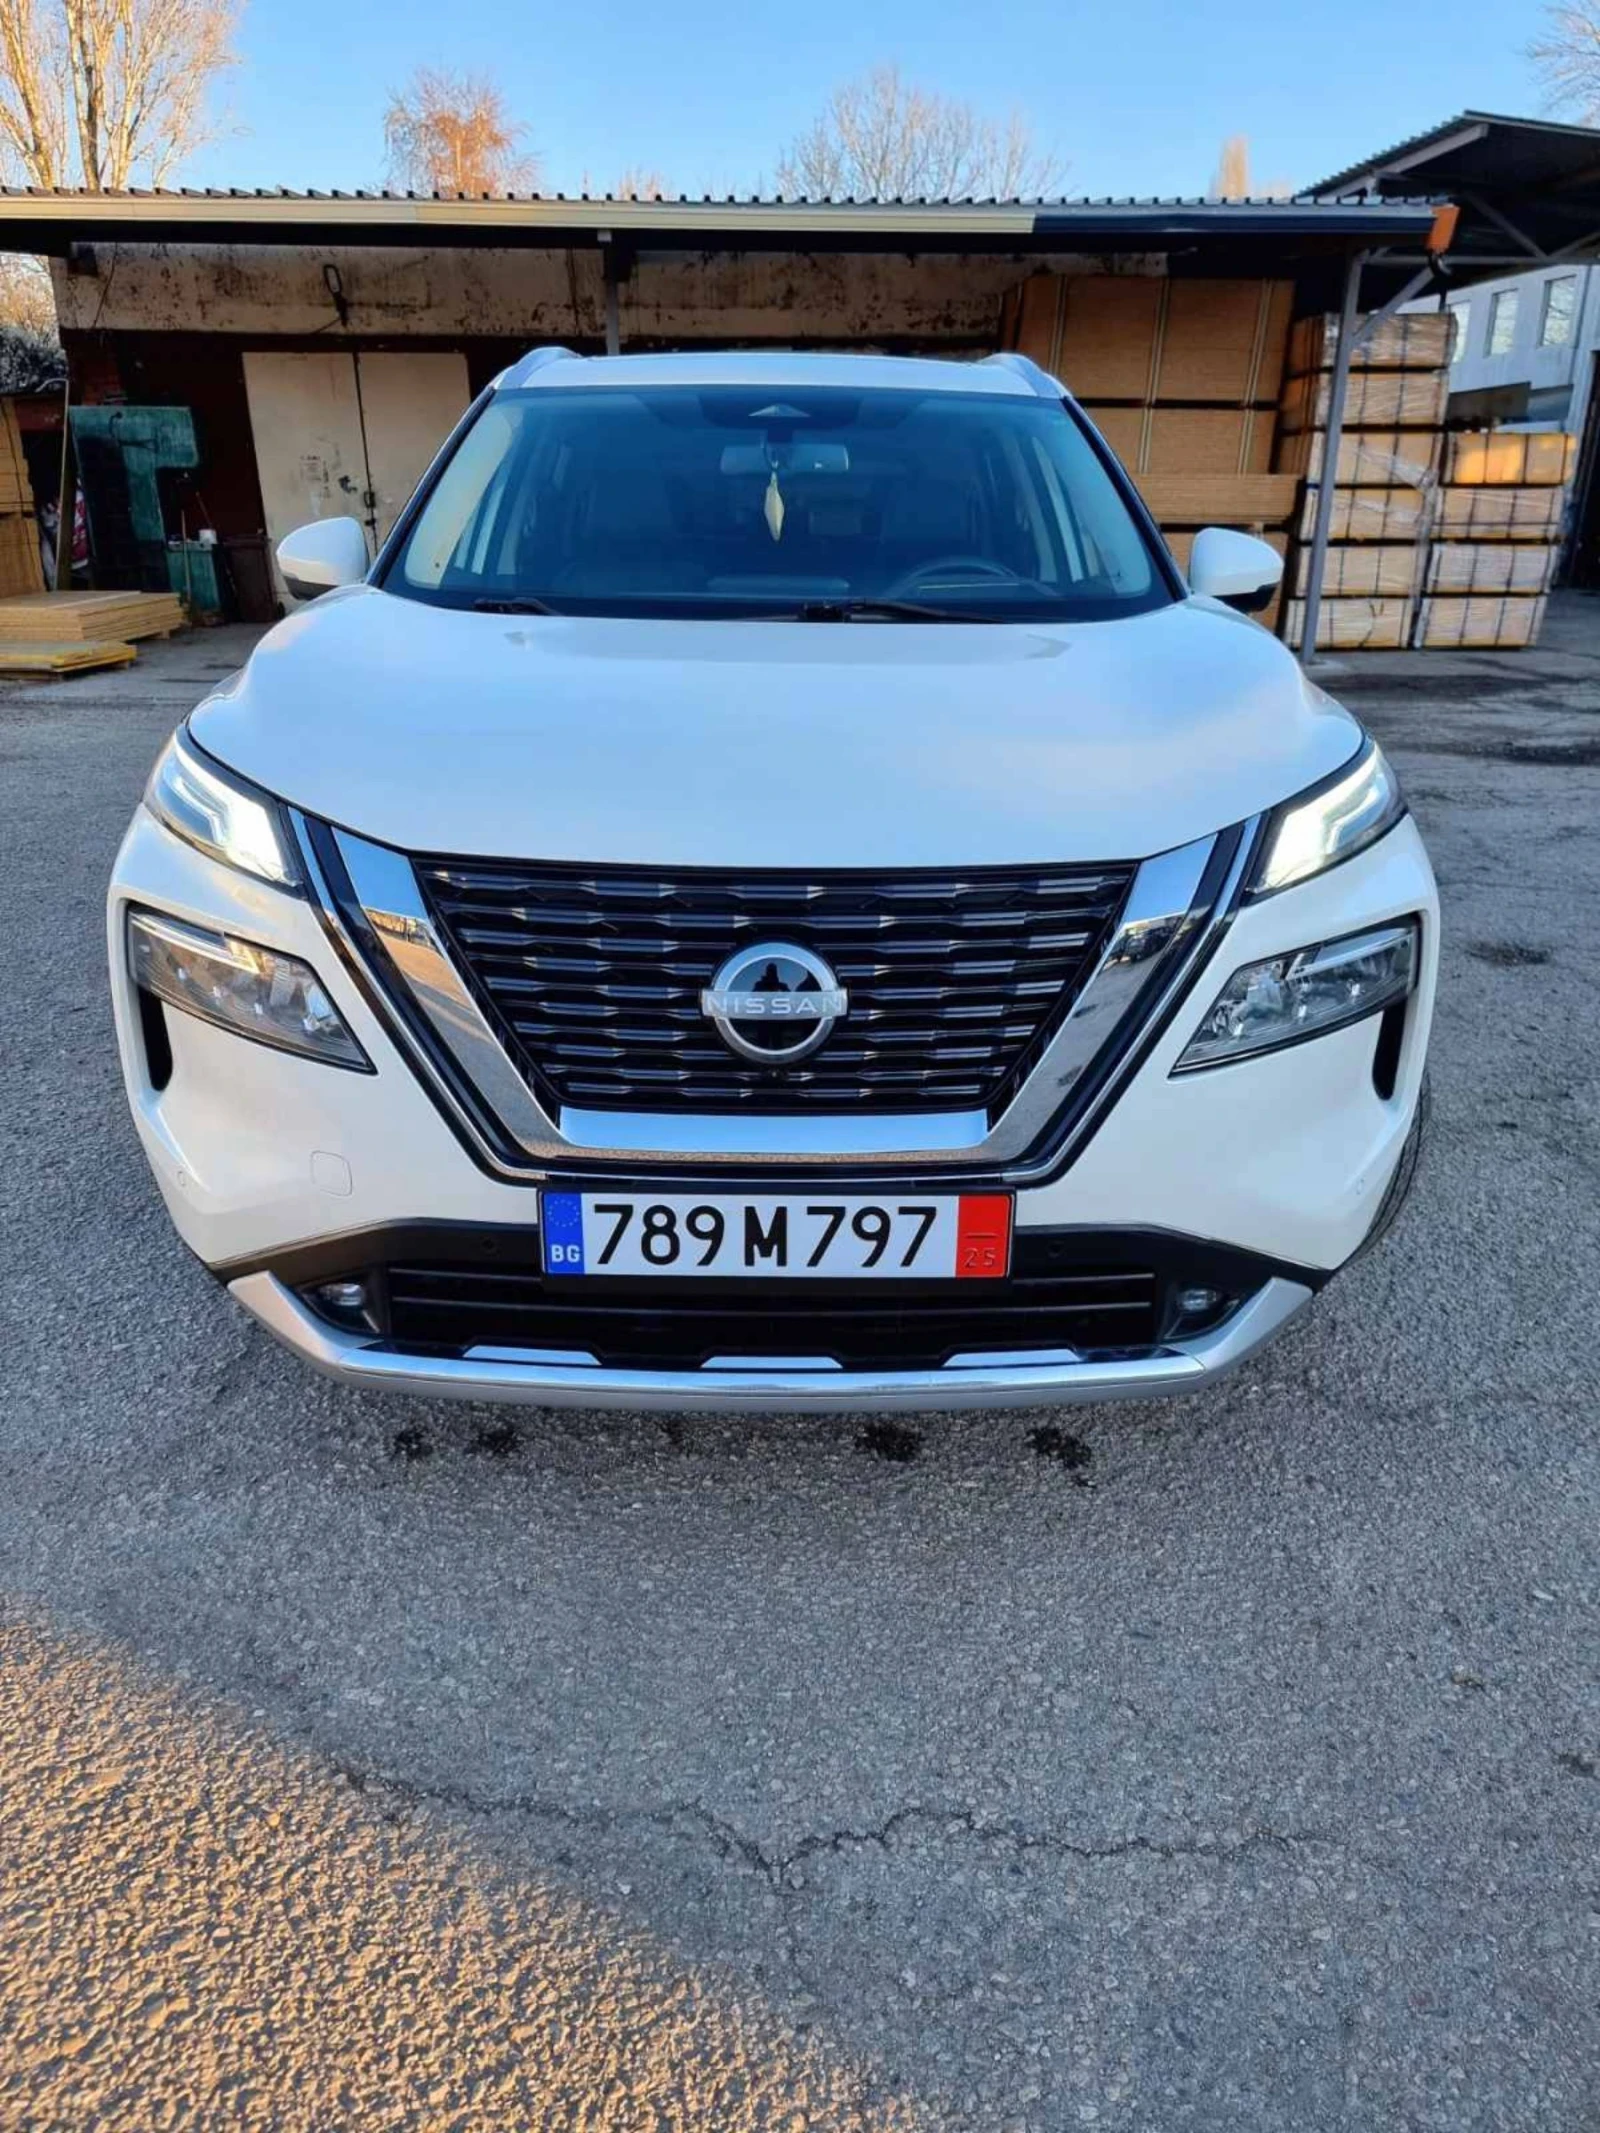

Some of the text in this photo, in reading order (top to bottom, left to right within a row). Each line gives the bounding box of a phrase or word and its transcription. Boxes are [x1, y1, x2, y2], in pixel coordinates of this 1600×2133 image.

[706, 995, 842, 1014] NISSAN
[594, 1204, 937, 1267] 789 M 797
[551, 1244, 580, 1263] BG
[964, 1247, 996, 1268] 25
